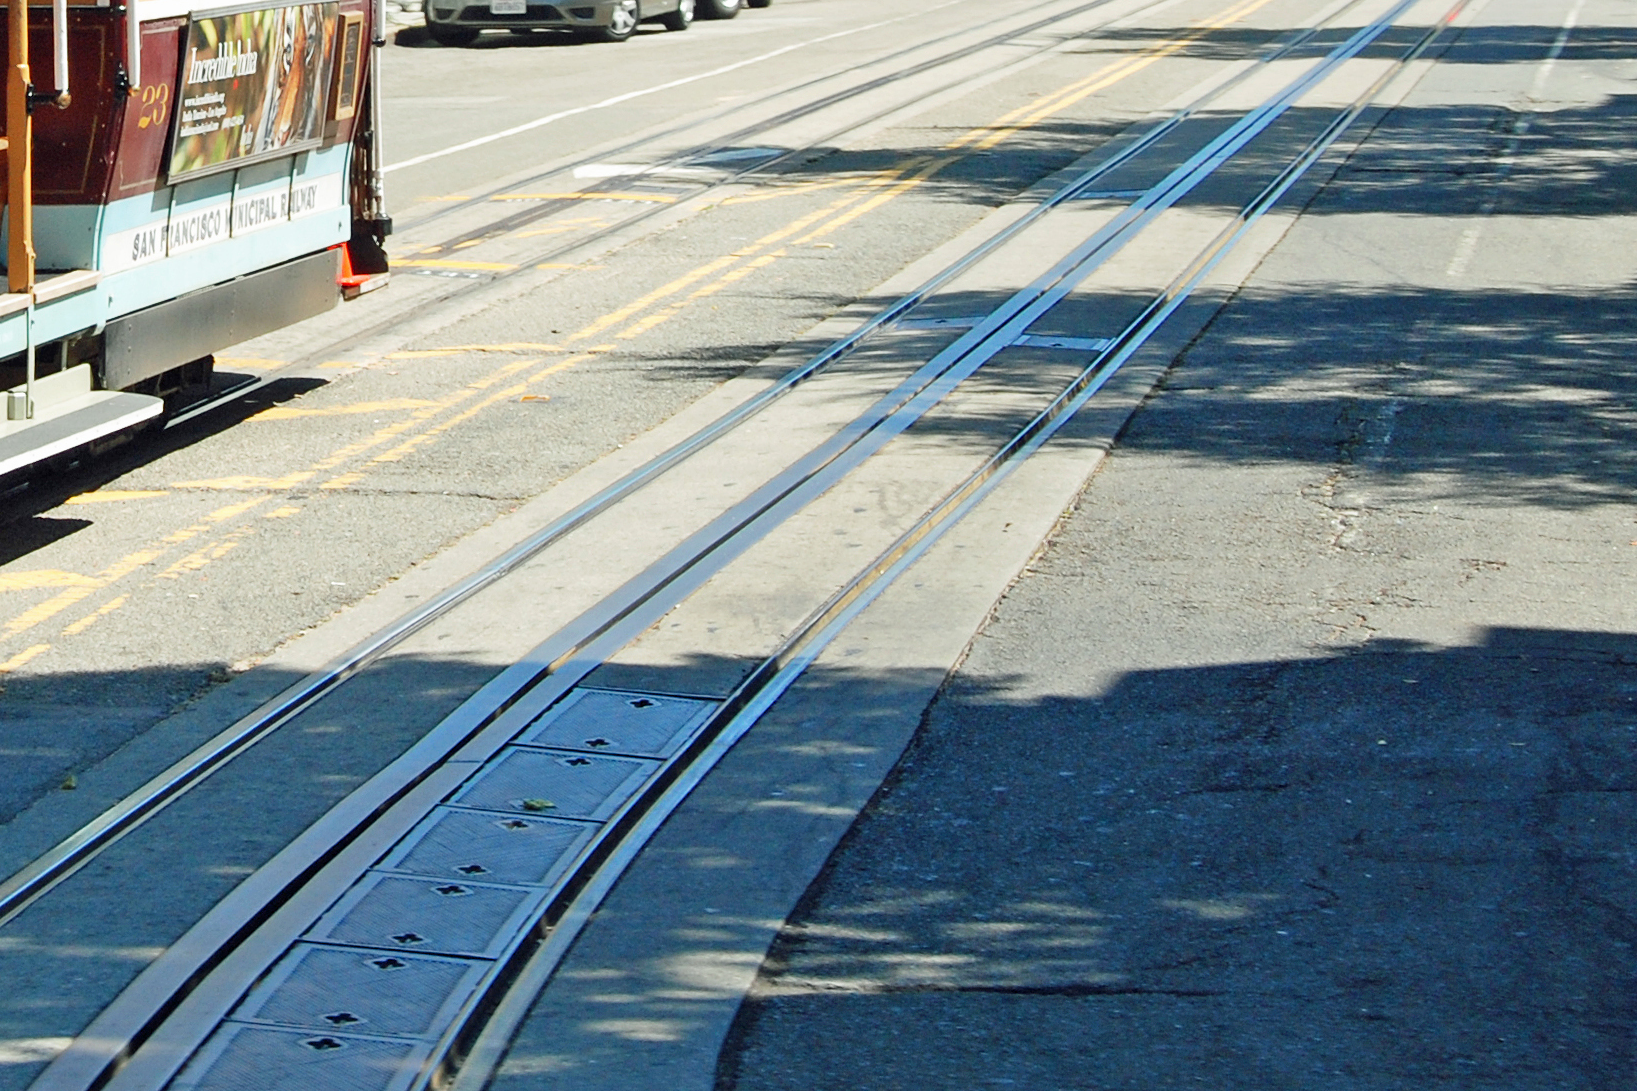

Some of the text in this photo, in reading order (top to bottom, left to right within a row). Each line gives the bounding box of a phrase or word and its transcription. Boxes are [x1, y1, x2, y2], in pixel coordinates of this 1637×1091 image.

[137, 82, 170, 129] 23
[132, 232, 157, 262] SAN
[160, 210, 222, 253] FRANCISCO
